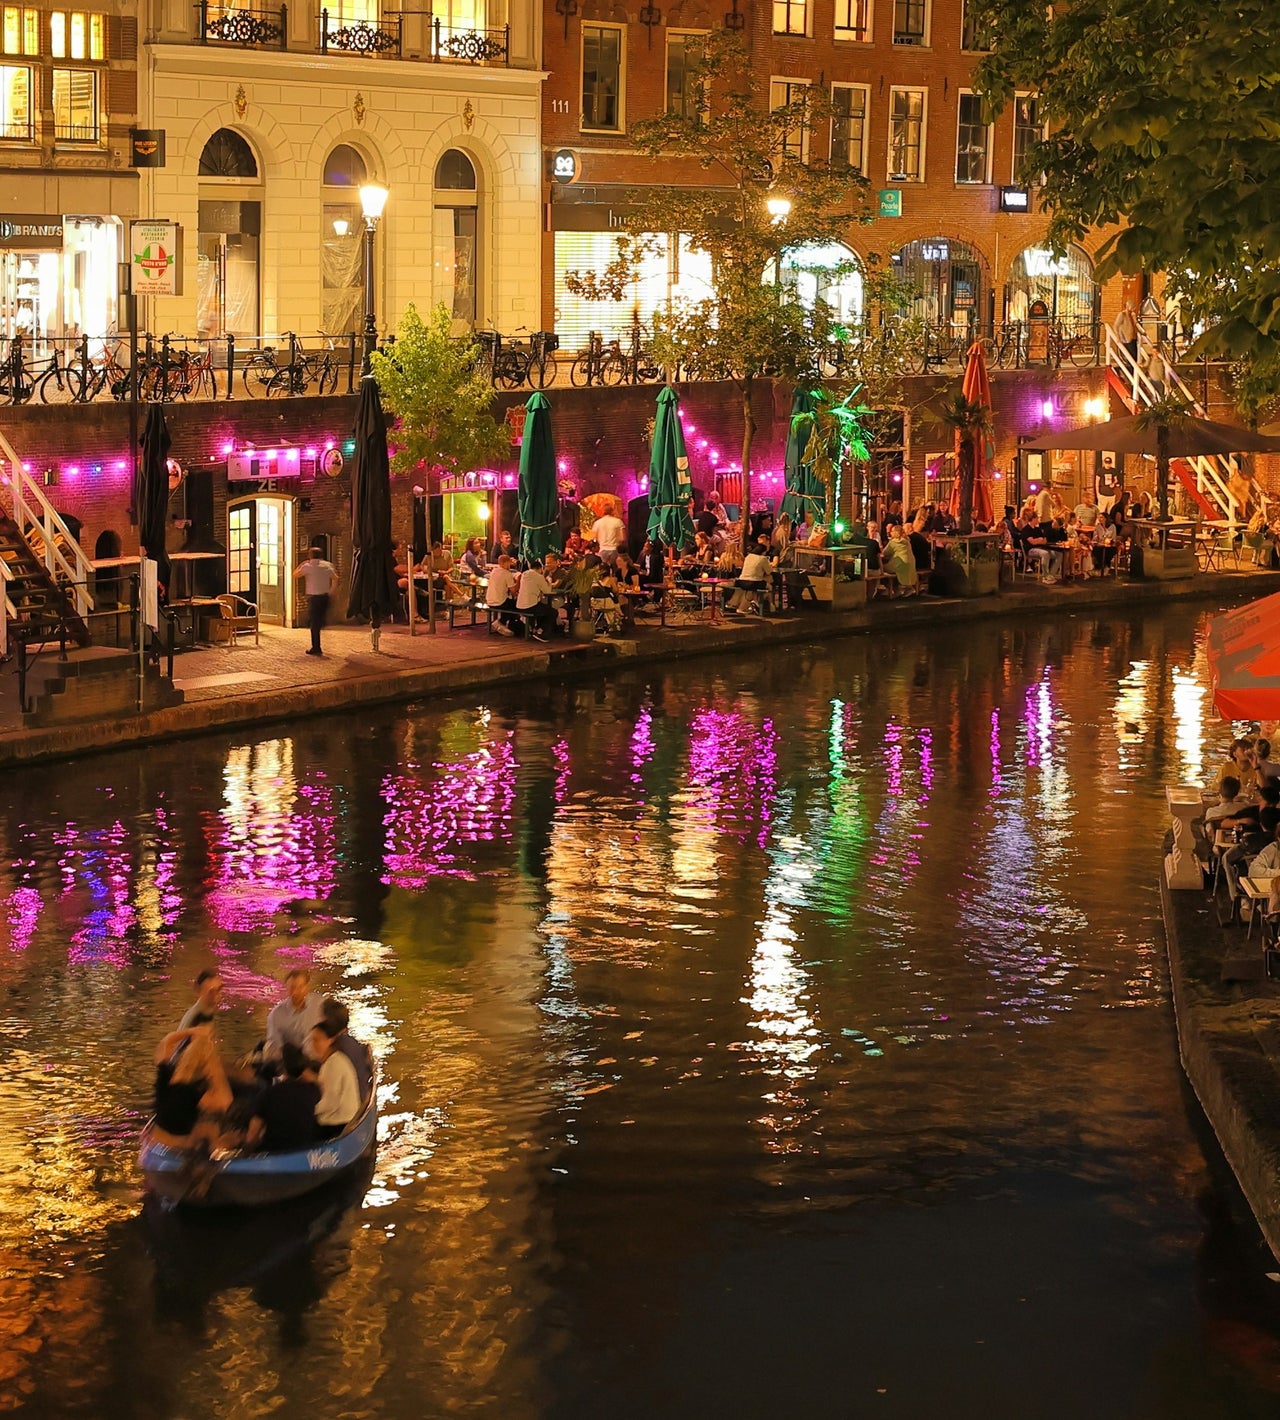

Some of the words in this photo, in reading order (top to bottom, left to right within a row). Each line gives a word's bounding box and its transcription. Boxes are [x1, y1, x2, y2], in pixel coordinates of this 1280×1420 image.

[552, 99, 569, 113] 111
[881, 201, 898, 210] Pearle
[12, 224, 63, 236] BRANDS
